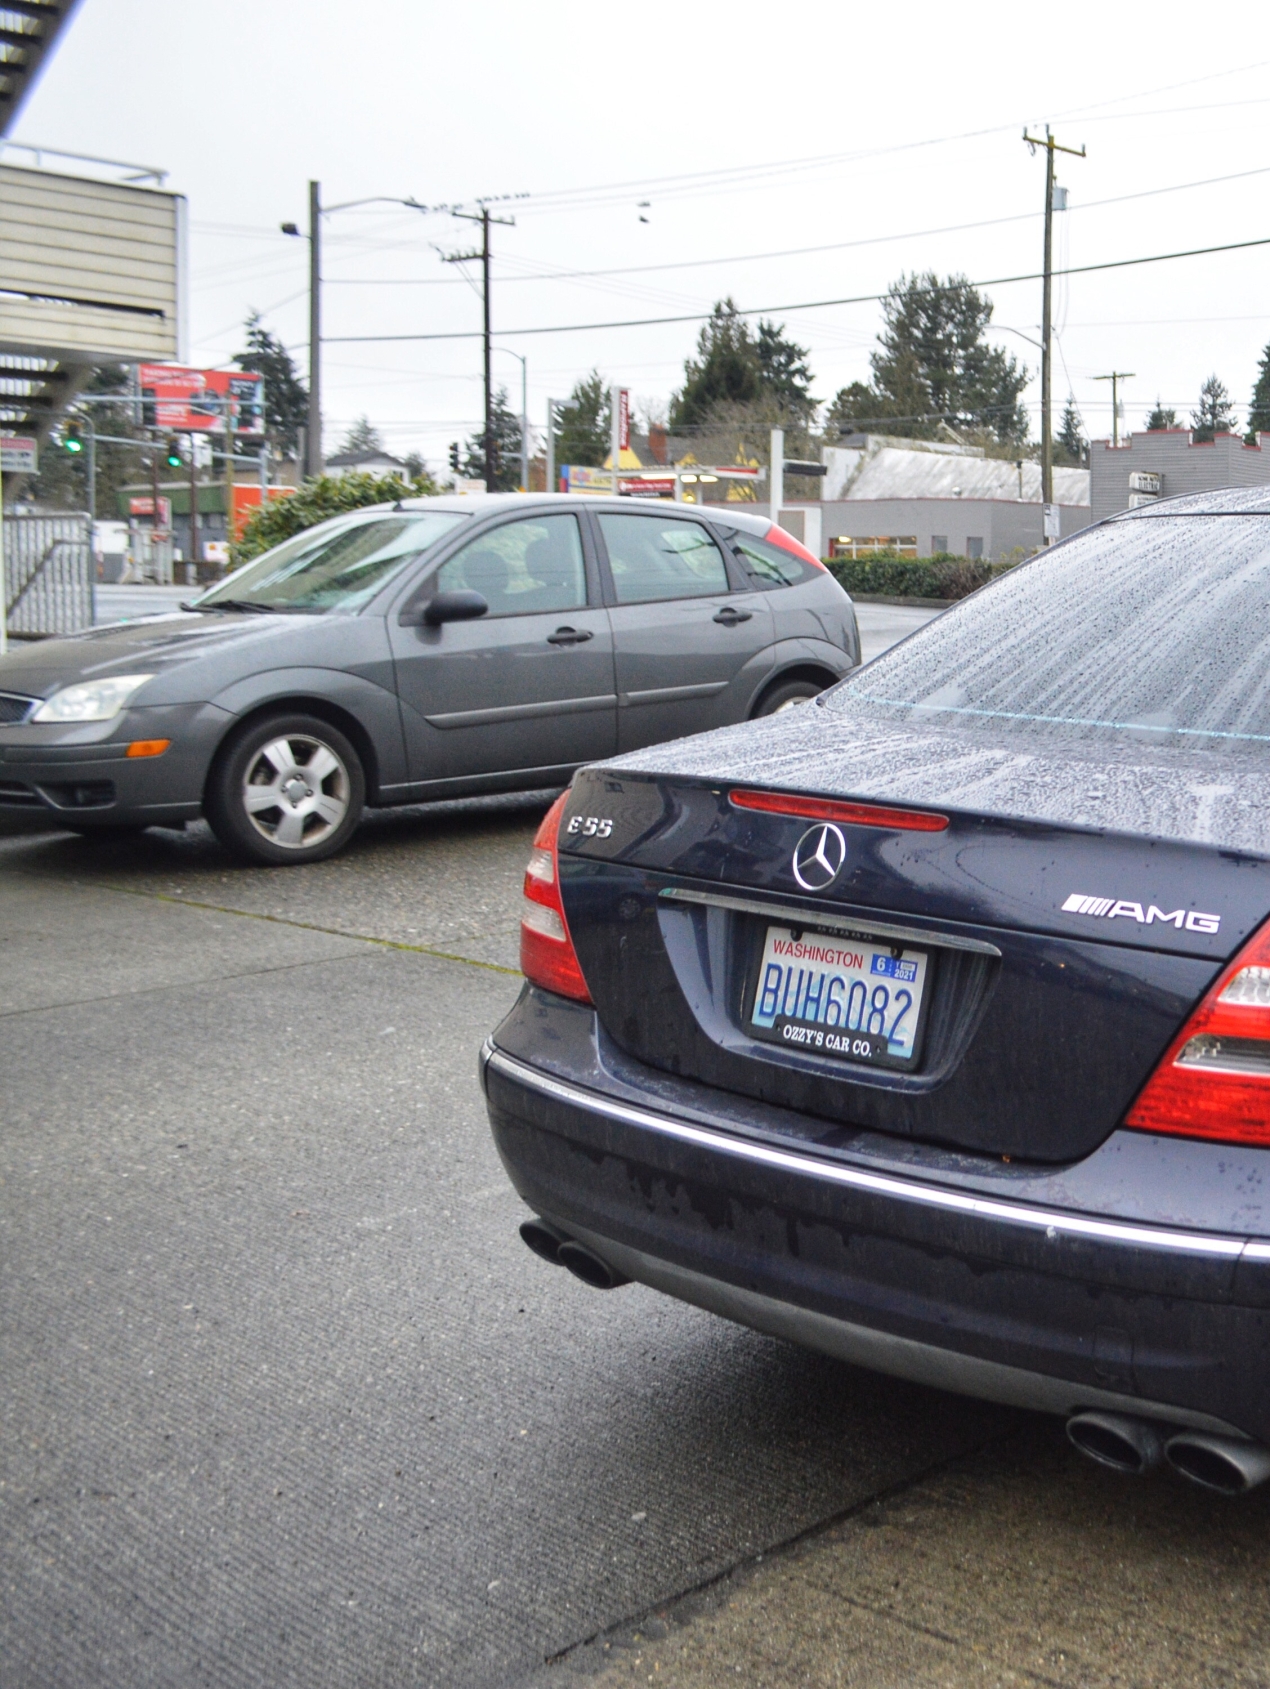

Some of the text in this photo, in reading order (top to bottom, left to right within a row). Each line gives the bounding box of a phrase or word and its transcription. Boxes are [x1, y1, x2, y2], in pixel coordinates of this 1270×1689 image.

[567, 815, 613, 838] E 55
[1108, 900, 1221, 934] AMG
[773, 939, 864, 970] WASHINGTON
[876, 957, 886, 972] 6
[894, 968, 914, 981] 2021
[759, 963, 913, 1046] BUH6082
[783, 1024, 872, 1057] OZZY'S CAR CO.
